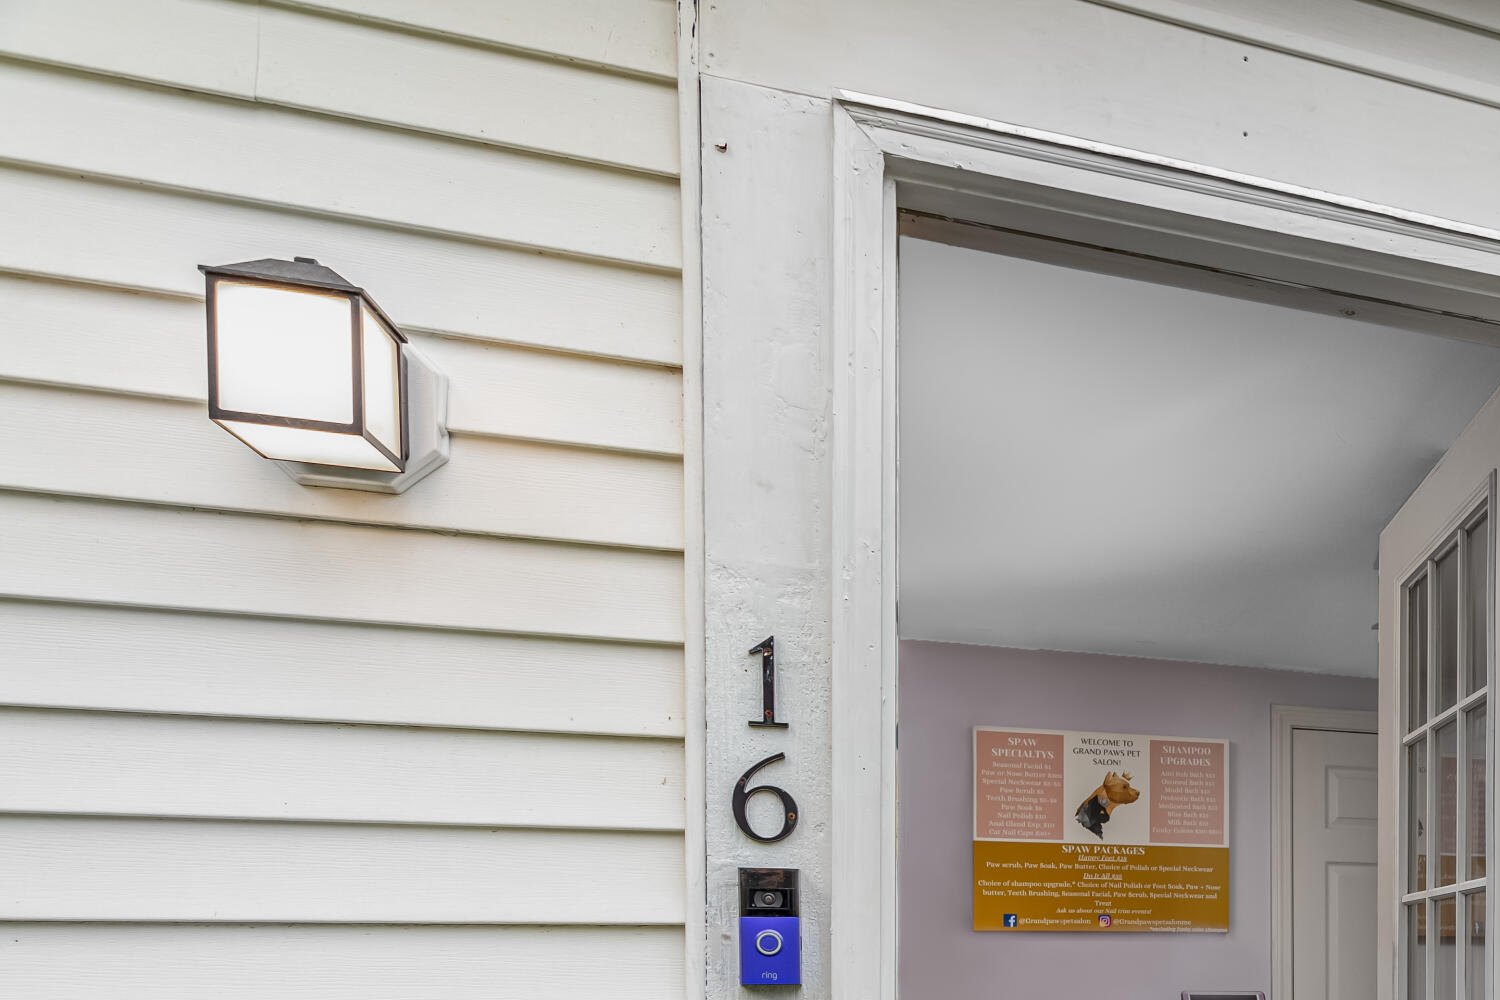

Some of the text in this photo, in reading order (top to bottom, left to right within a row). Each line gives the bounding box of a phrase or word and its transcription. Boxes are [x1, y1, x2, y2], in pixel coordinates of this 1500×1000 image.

[1008, 737, 1038, 746] SPAW
[1081, 738, 1120, 746] WELCOME
[992, 748, 1055, 759] SPECIALTYS
[1073, 747, 1101, 755] GRAND
[1163, 746, 1211, 755] SHAMPOO
[1160, 756, 1210, 766] UPGRADES
[1062, 845, 1145, 855] SPAW PACKAGES
[1011, 880, 1041, 888] shampoo
[762, 970, 778, 981] ring
